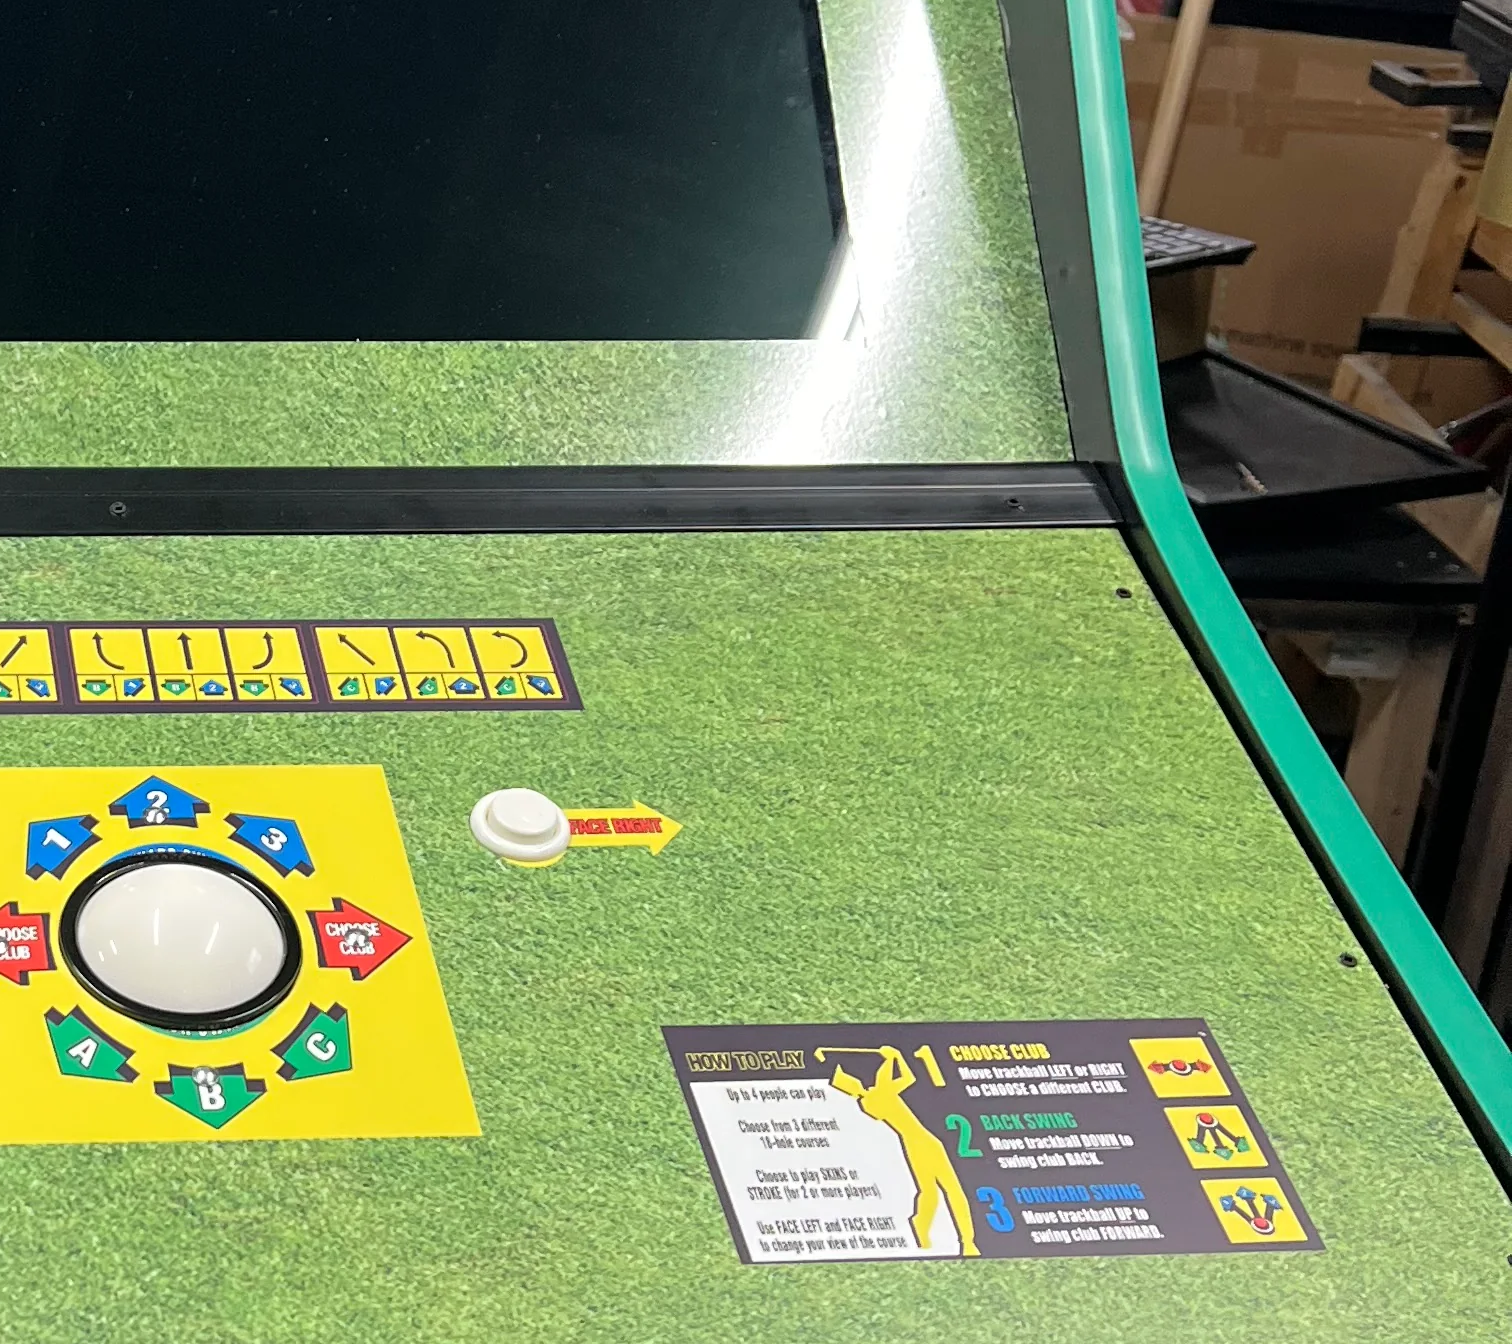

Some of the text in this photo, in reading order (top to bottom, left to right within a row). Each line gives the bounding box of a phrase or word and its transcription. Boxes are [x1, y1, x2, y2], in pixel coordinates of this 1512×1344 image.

[145, 789, 168, 813] 2
[569, 818, 663, 835] FACE RIGHT
[41, 827, 73, 849] 1
[260, 827, 289, 852] 3
[66, 1036, 99, 1069] A
[305, 1032, 337, 1062] C
[949, 1043, 1050, 1062] CHOOSE CLUB
[685, 1050, 805, 1072] HOW TO PLAY
[914, 1045, 946, 1087] 1
[958, 1063, 1127, 1080] Move trackball LEFT or RIGHT
[197, 1081, 228, 1112] B
[726, 1085, 827, 1103] Up to 4 people can play
[965, 1080, 1127, 1097] to CHOOSE a different CLUB.
[738, 1117, 840, 1133] Choose from 3 different
[980, 1112, 1078, 1131] BACK SWING
[760, 1135, 830, 1149] 18-hole courses
[944, 1114, 984, 1158] 2
[989, 1133, 1134, 1151] Move trackball DOWN to
[997, 1151, 1104, 1169] swing club BACK.
[756, 1167, 859, 1184] Choose to play SKINS or
[747, 1182, 882, 1203] STROKE (for 2 or more players)
[1012, 1183, 1145, 1205] FORWARD SWING
[976, 1186, 1016, 1233] 3
[1022, 1207, 1150, 1225] Move trackball UP to
[756, 1216, 896, 1235] Use FACE LEFT and FACE RIGHT
[1031, 1225, 1165, 1244] swing club FORWARD.
[759, 1234, 908, 1254] to change your view of the course
